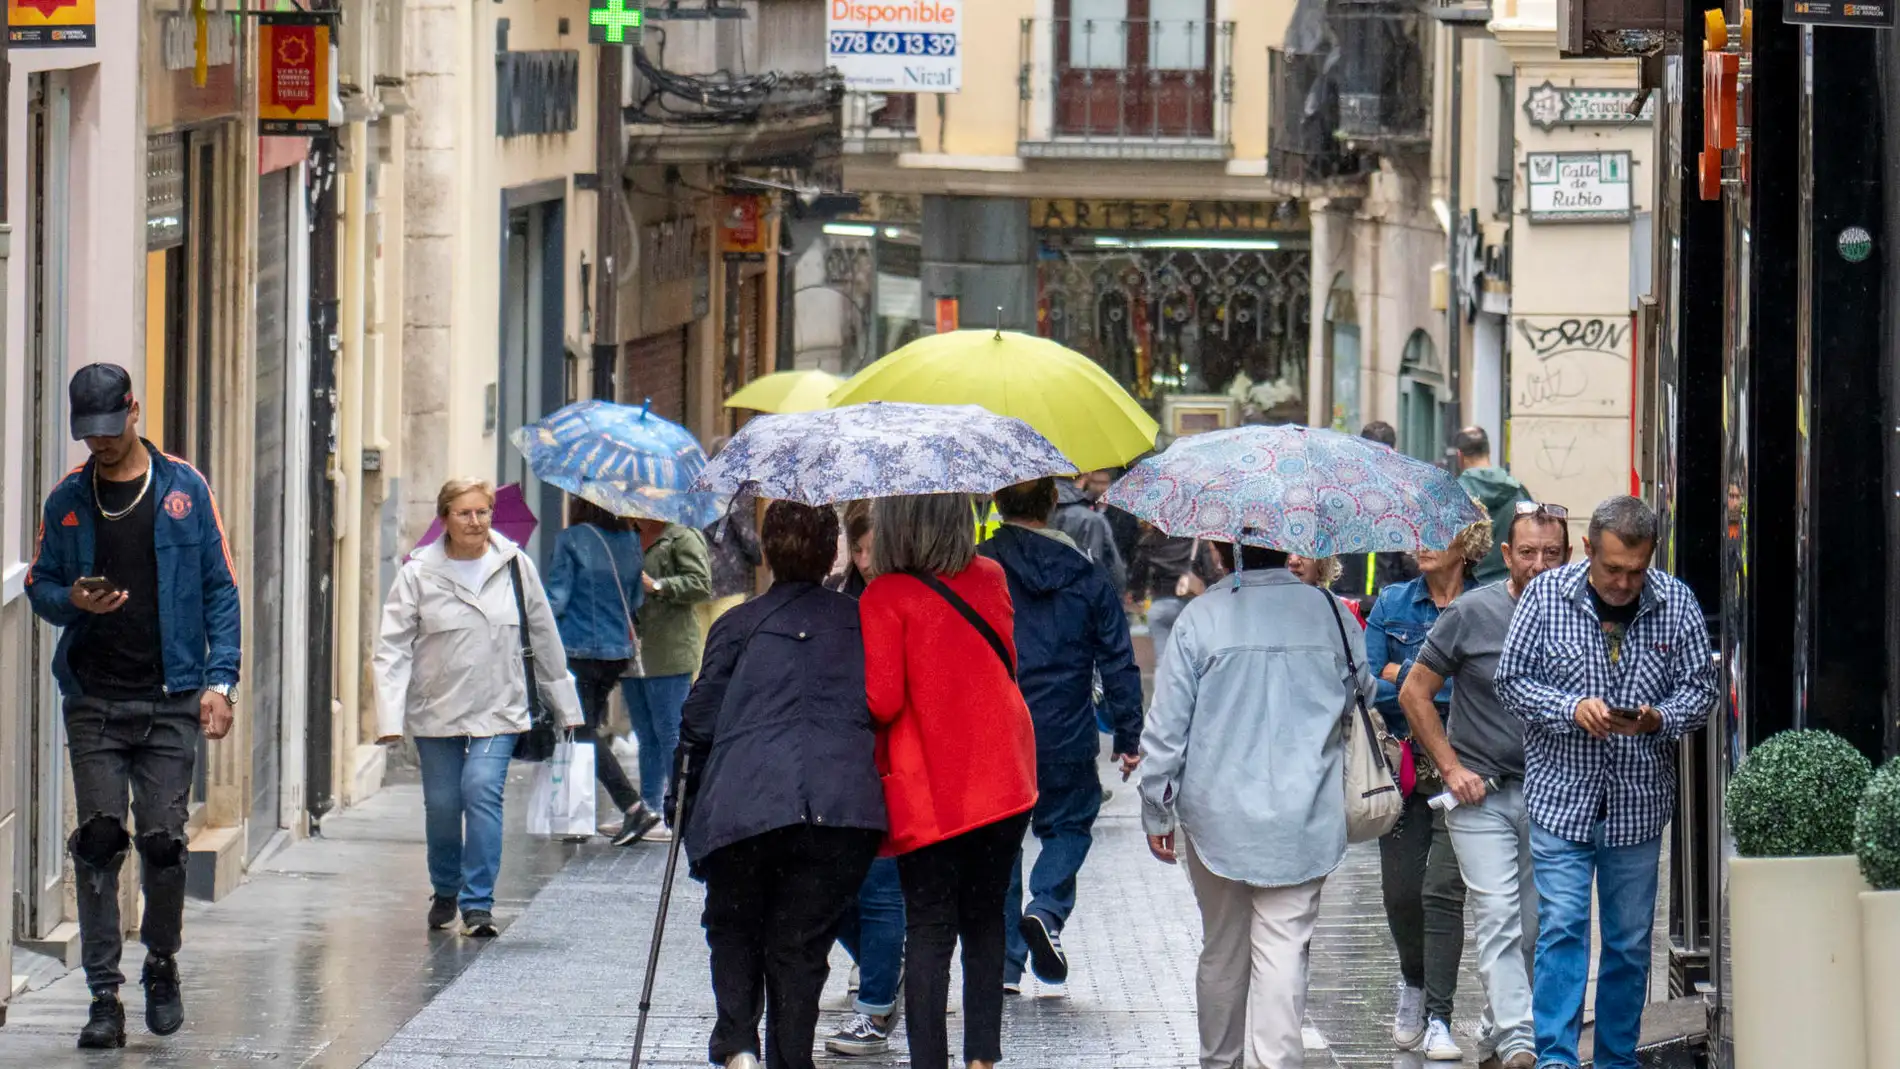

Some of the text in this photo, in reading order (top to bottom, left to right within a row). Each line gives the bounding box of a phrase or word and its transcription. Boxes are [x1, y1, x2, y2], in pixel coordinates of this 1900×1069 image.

[832, 0, 954, 26] Disponible
[831, 32, 955, 55] 978 60 13 39
[1561, 164, 1599, 178] Calle
[1570, 178, 1587, 189] de
[1552, 187, 1603, 207] Rubio
